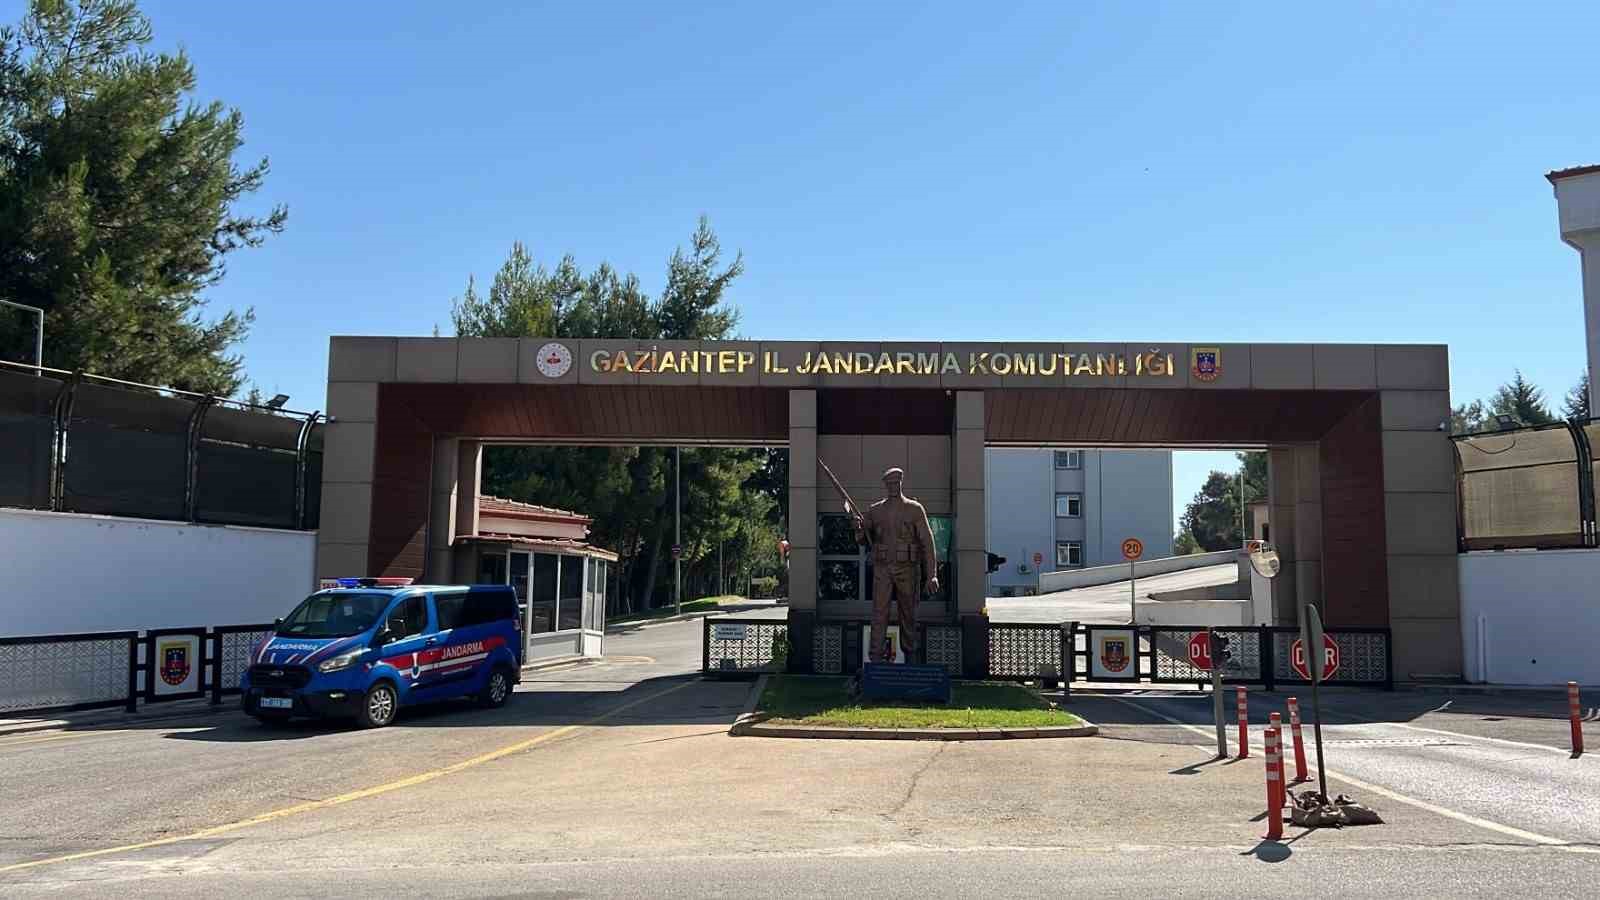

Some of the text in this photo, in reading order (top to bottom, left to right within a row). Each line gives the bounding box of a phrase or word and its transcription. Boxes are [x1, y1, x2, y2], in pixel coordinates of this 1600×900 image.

[590, 346, 754, 373] GAZİANTEP
[796, 351, 961, 374] JANDARMA
[969, 348, 1174, 376] KOMUTANLIĞI
[1126, 543, 1139, 554] 20
[441, 641, 484, 659] JANDARMA
[1295, 647, 1336, 665] DR
